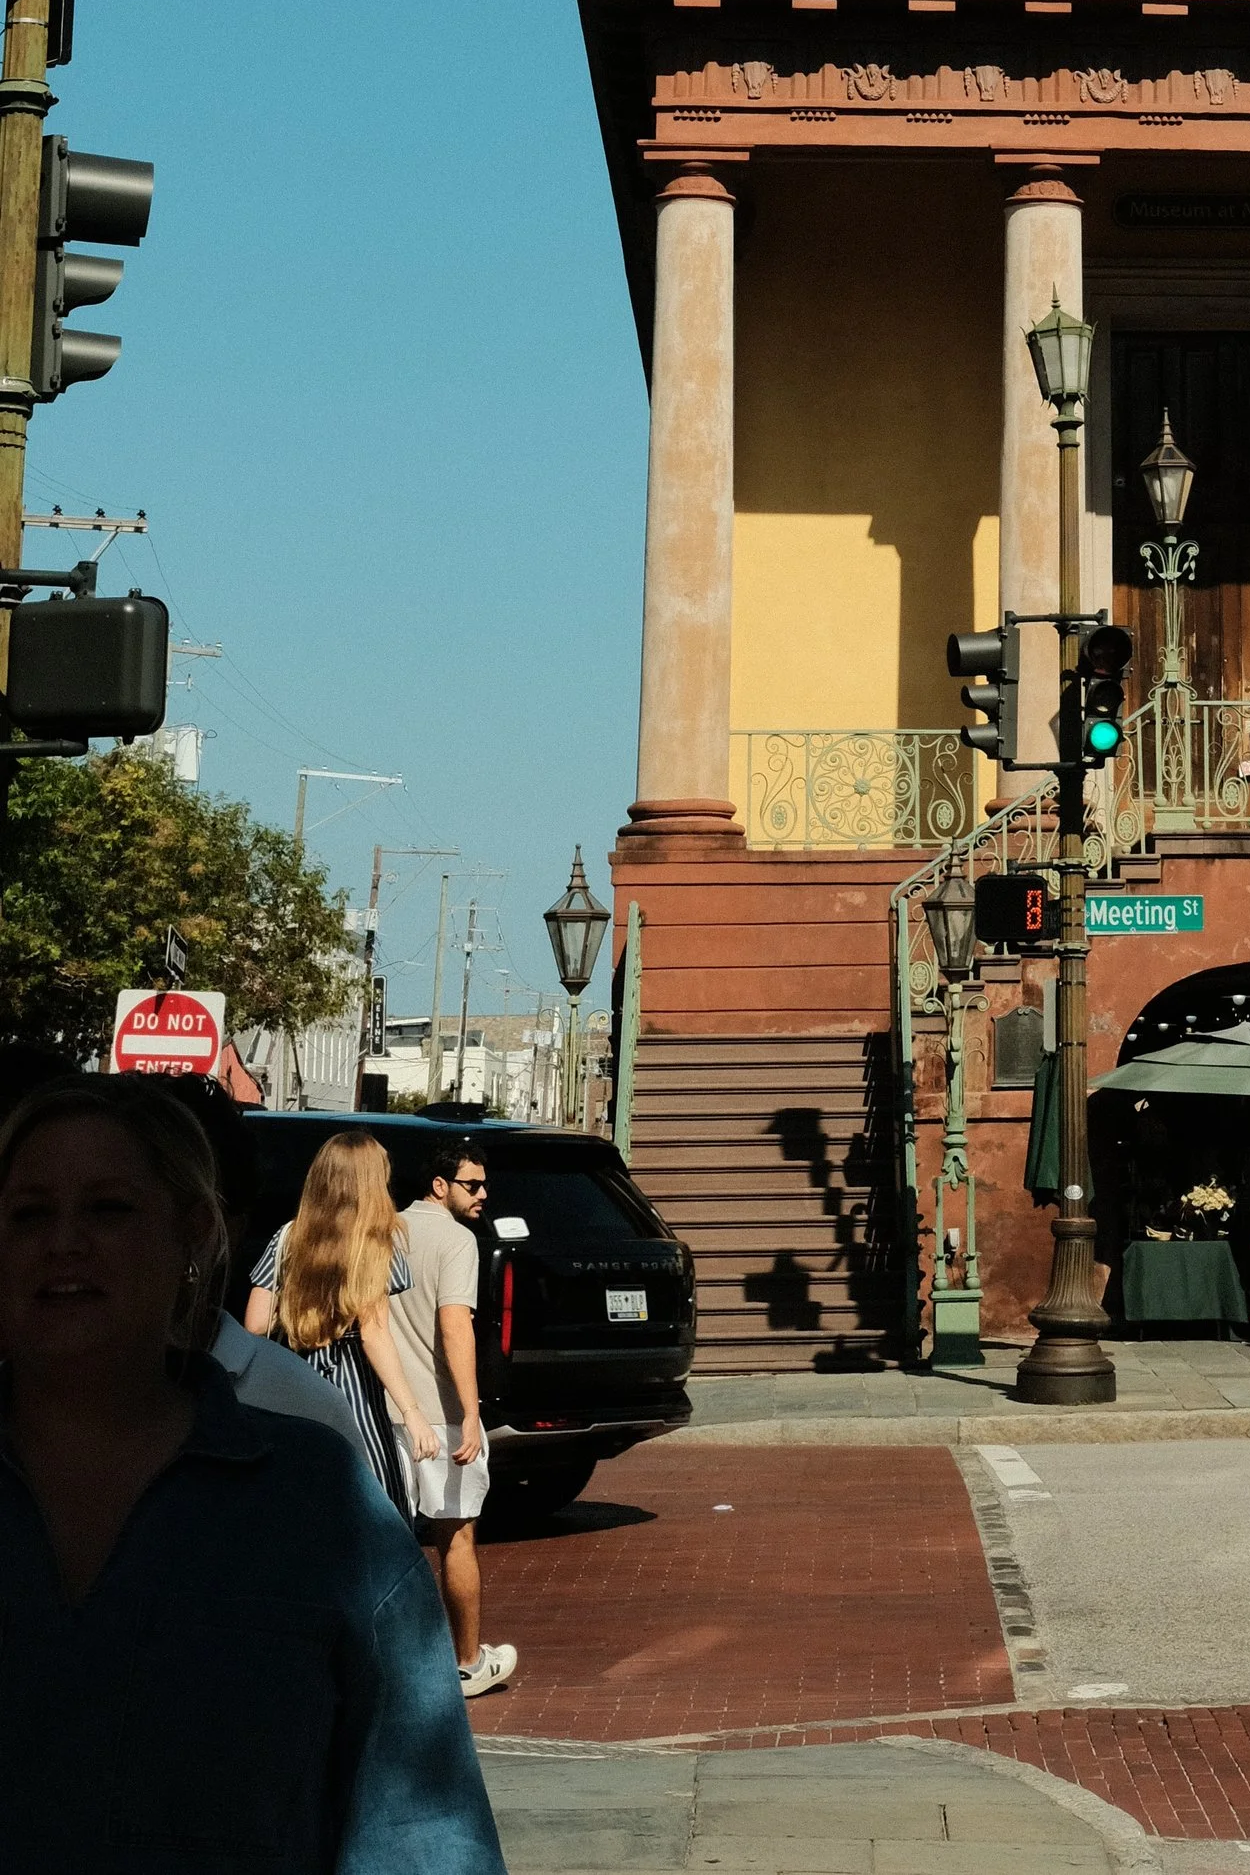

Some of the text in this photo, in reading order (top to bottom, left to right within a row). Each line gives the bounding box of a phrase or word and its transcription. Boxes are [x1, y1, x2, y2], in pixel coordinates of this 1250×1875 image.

[1130, 201, 1211, 218] Museum
[1218, 204, 1234, 218] at
[1090, 899, 1199, 930] Meeting St
[133, 1013, 206, 1031] DO NOT
[572, 1261, 632, 1270] RANGE
